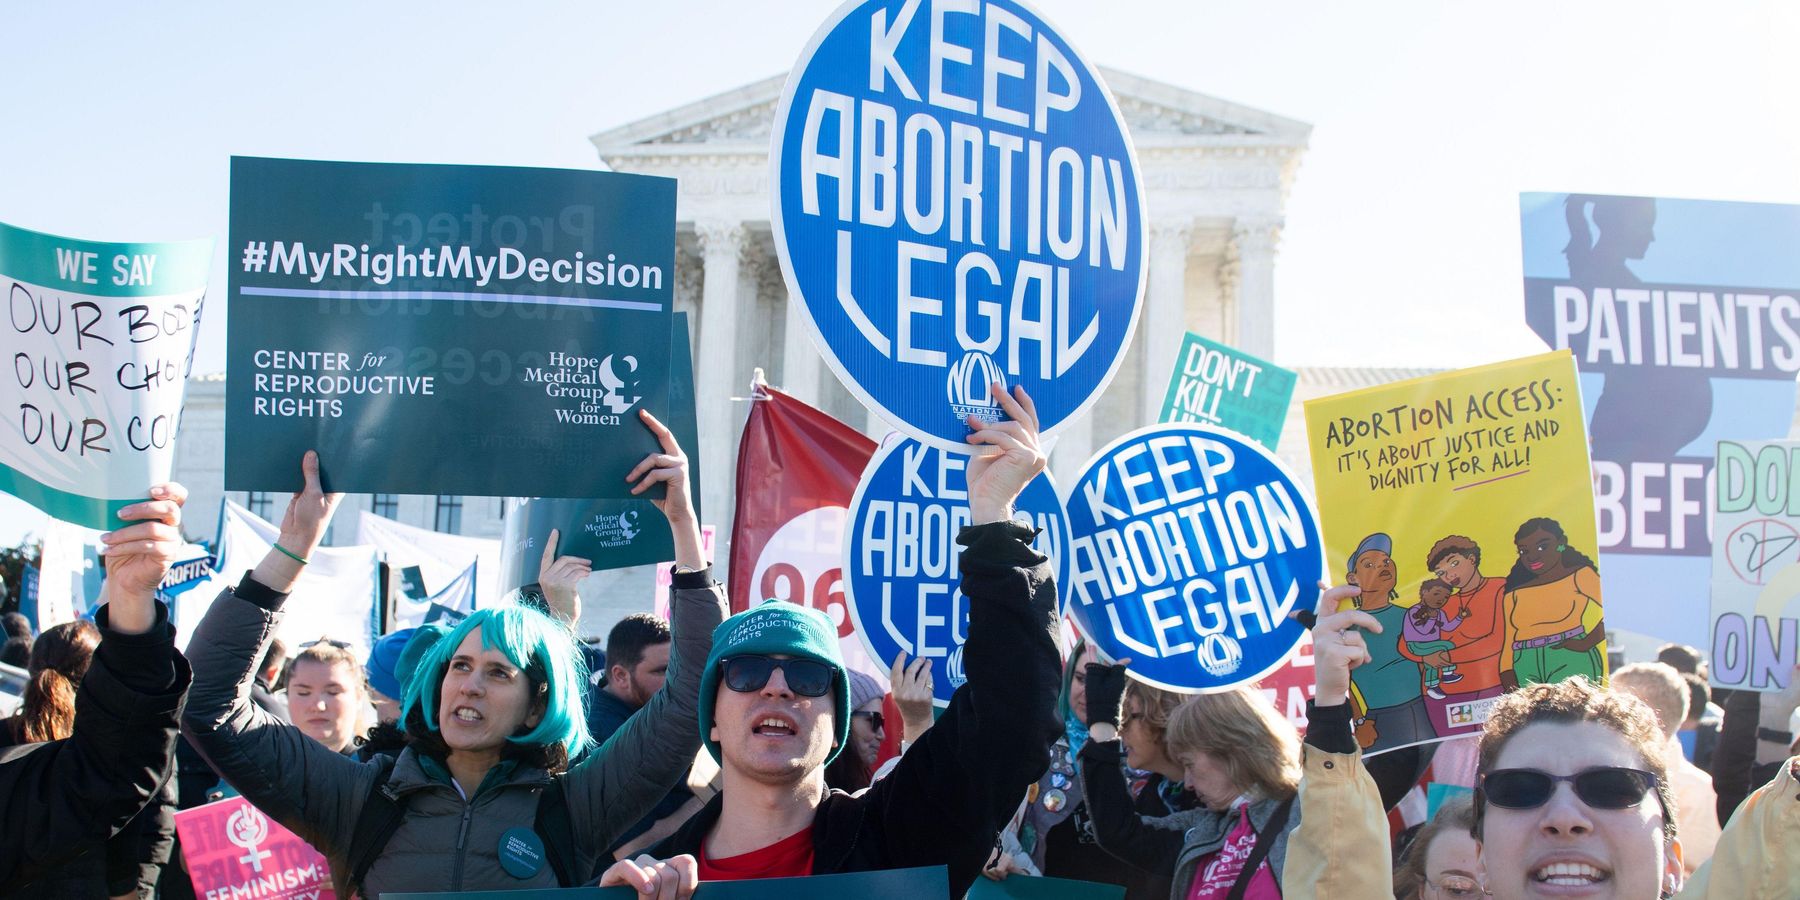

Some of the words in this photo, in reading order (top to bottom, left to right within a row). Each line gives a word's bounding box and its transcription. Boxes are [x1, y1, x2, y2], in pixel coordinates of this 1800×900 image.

[869, 0, 1082, 134] KEEP
[801, 88, 1127, 271] ABORTION
[56, 248, 98, 285] WE
[112, 254, 157, 286] SAY
[242, 241, 662, 290] #MyRightMyDecision
[10, 283, 114, 351] OUR
[837, 230, 1100, 380] LEGAL
[1553, 286, 1800, 373] PATIENTS
[15, 352, 96, 396] OUR
[254, 350, 351, 370] CENTER
[356, 352, 387, 371] for
[524, 368, 597, 385] Medical
[549, 352, 599, 374] Hope
[1183, 342, 1263, 397] DON'T
[255, 373, 434, 395] REPRODUCTIVE
[546, 383, 604, 404] Group
[1173, 375, 1222, 423] KILL
[20, 402, 110, 456] OUR
[255, 397, 343, 417] RIGHTS
[555, 409, 620, 425] Women
[580, 401, 600, 413] for
[953, 406, 1003, 416] NATIONAL
[1326, 397, 1453, 448] ABORTION
[1466, 379, 1563, 423] ACCESS:
[1338, 449, 1371, 472] IT'S
[1377, 437, 1436, 467] ABOUT
[1444, 426, 1516, 457] JUSTICE
[1523, 418, 1560, 442] AND
[1083, 435, 1236, 527] KEEP
[1369, 462, 1440, 491] DIGNITY
[1448, 455, 1485, 480] FOR
[1492, 446, 1531, 472] ALL!
[585, 521, 619, 531] Medical
[595, 514, 619, 523] Hope
[1597, 461, 1715, 549] BEF
[595, 529, 622, 537] Group
[600, 539, 631, 548] Women
[1073, 480, 1307, 606] ABORTION
[1105, 562, 1300, 658] LEGAL
[205, 863, 325, 900] FEMINISM:
